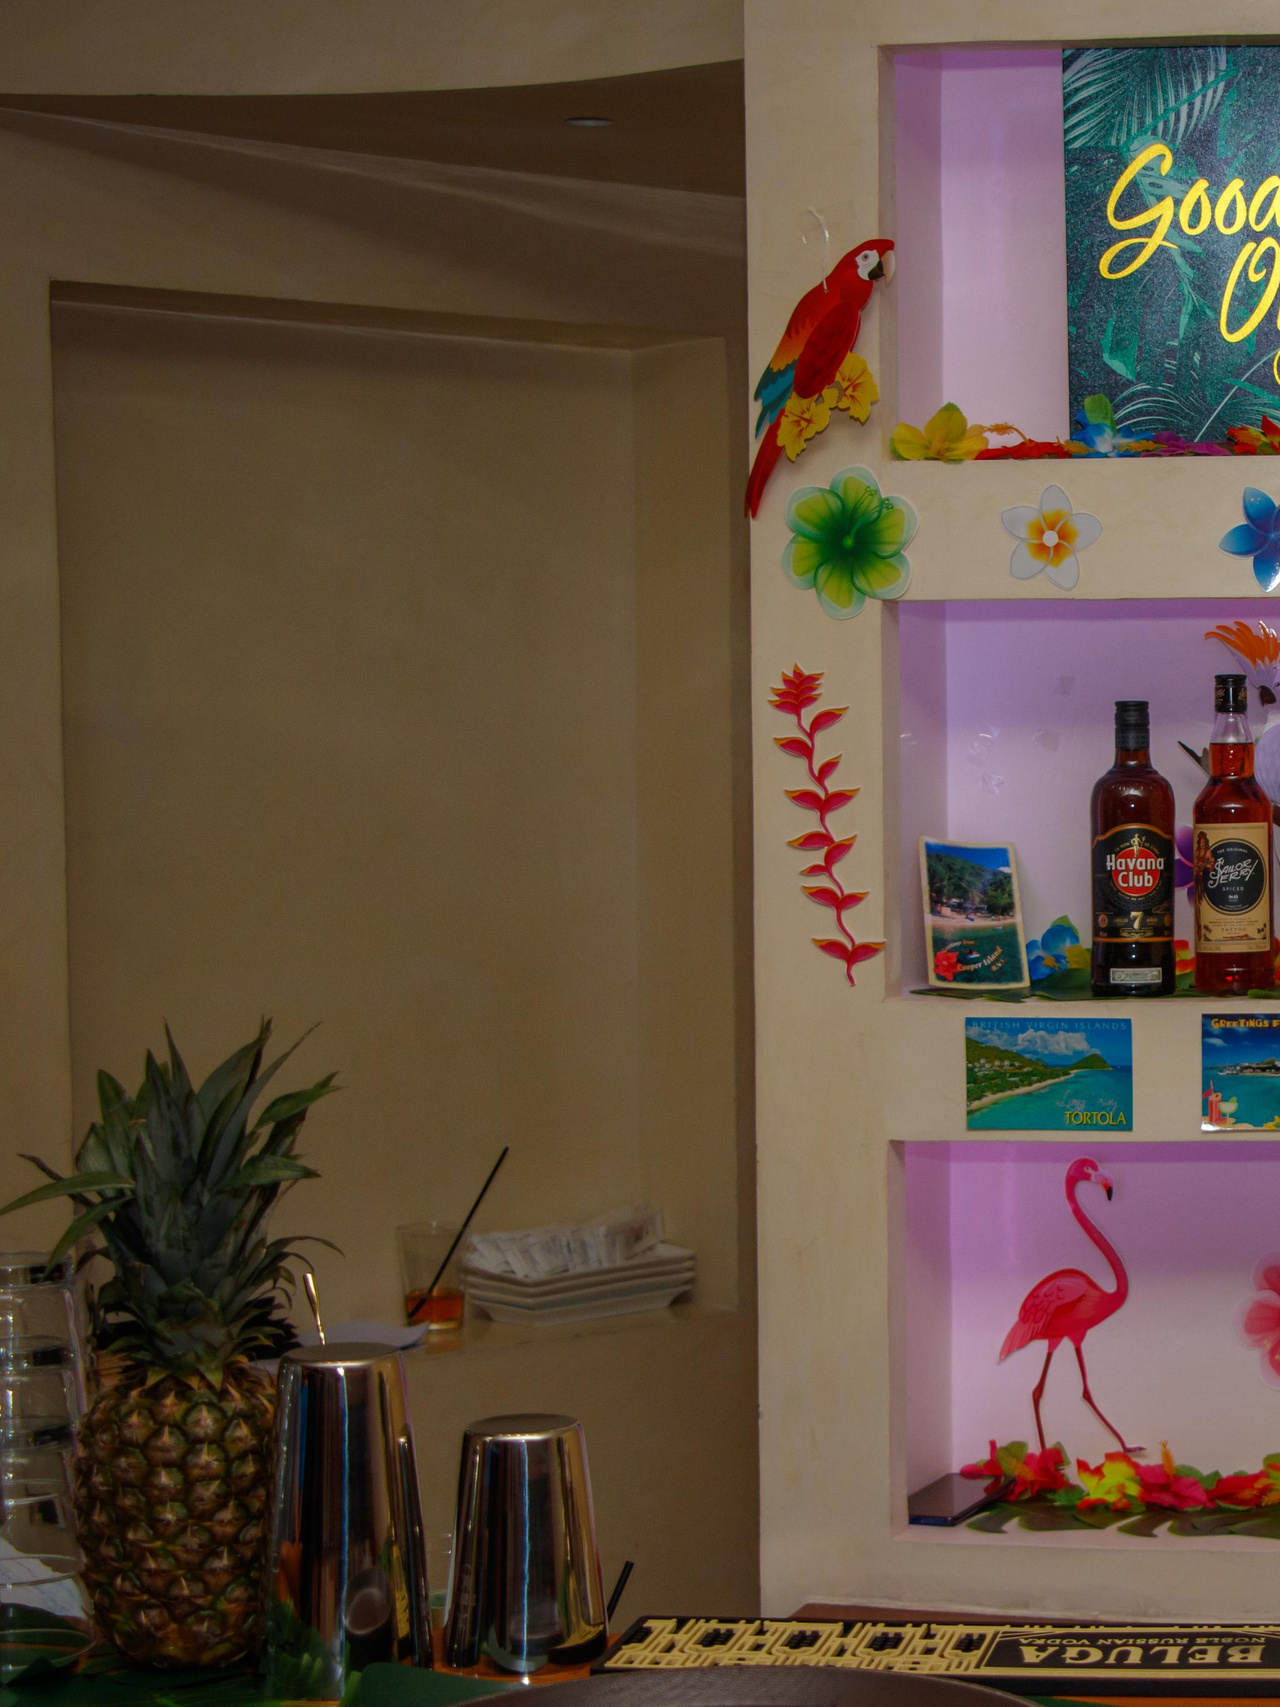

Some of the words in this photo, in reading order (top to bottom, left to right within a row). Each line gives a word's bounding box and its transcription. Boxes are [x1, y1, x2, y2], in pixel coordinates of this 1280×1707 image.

[1106, 854, 1165, 871] Havana
[1118, 872, 1154, 888] Club
[1130, 911, 1144, 930] 7
[957, 962, 983, 972] Cooper
[983, 945, 1003, 966] Island
[972, 1021, 1020, 1030] BRITISH
[1026, 1021, 1069, 1030] VIRGIN
[1075, 1021, 1127, 1030] ISLANDS
[1064, 1111, 1127, 1126] TORTOLA
[1017, 1637, 1091, 1646] VODKA
[1096, 1636, 1189, 1646] RUSSIAN
[1195, 1636, 1266, 1644] NOBLE
[1019, 1644, 1266, 1665] BELUGA
